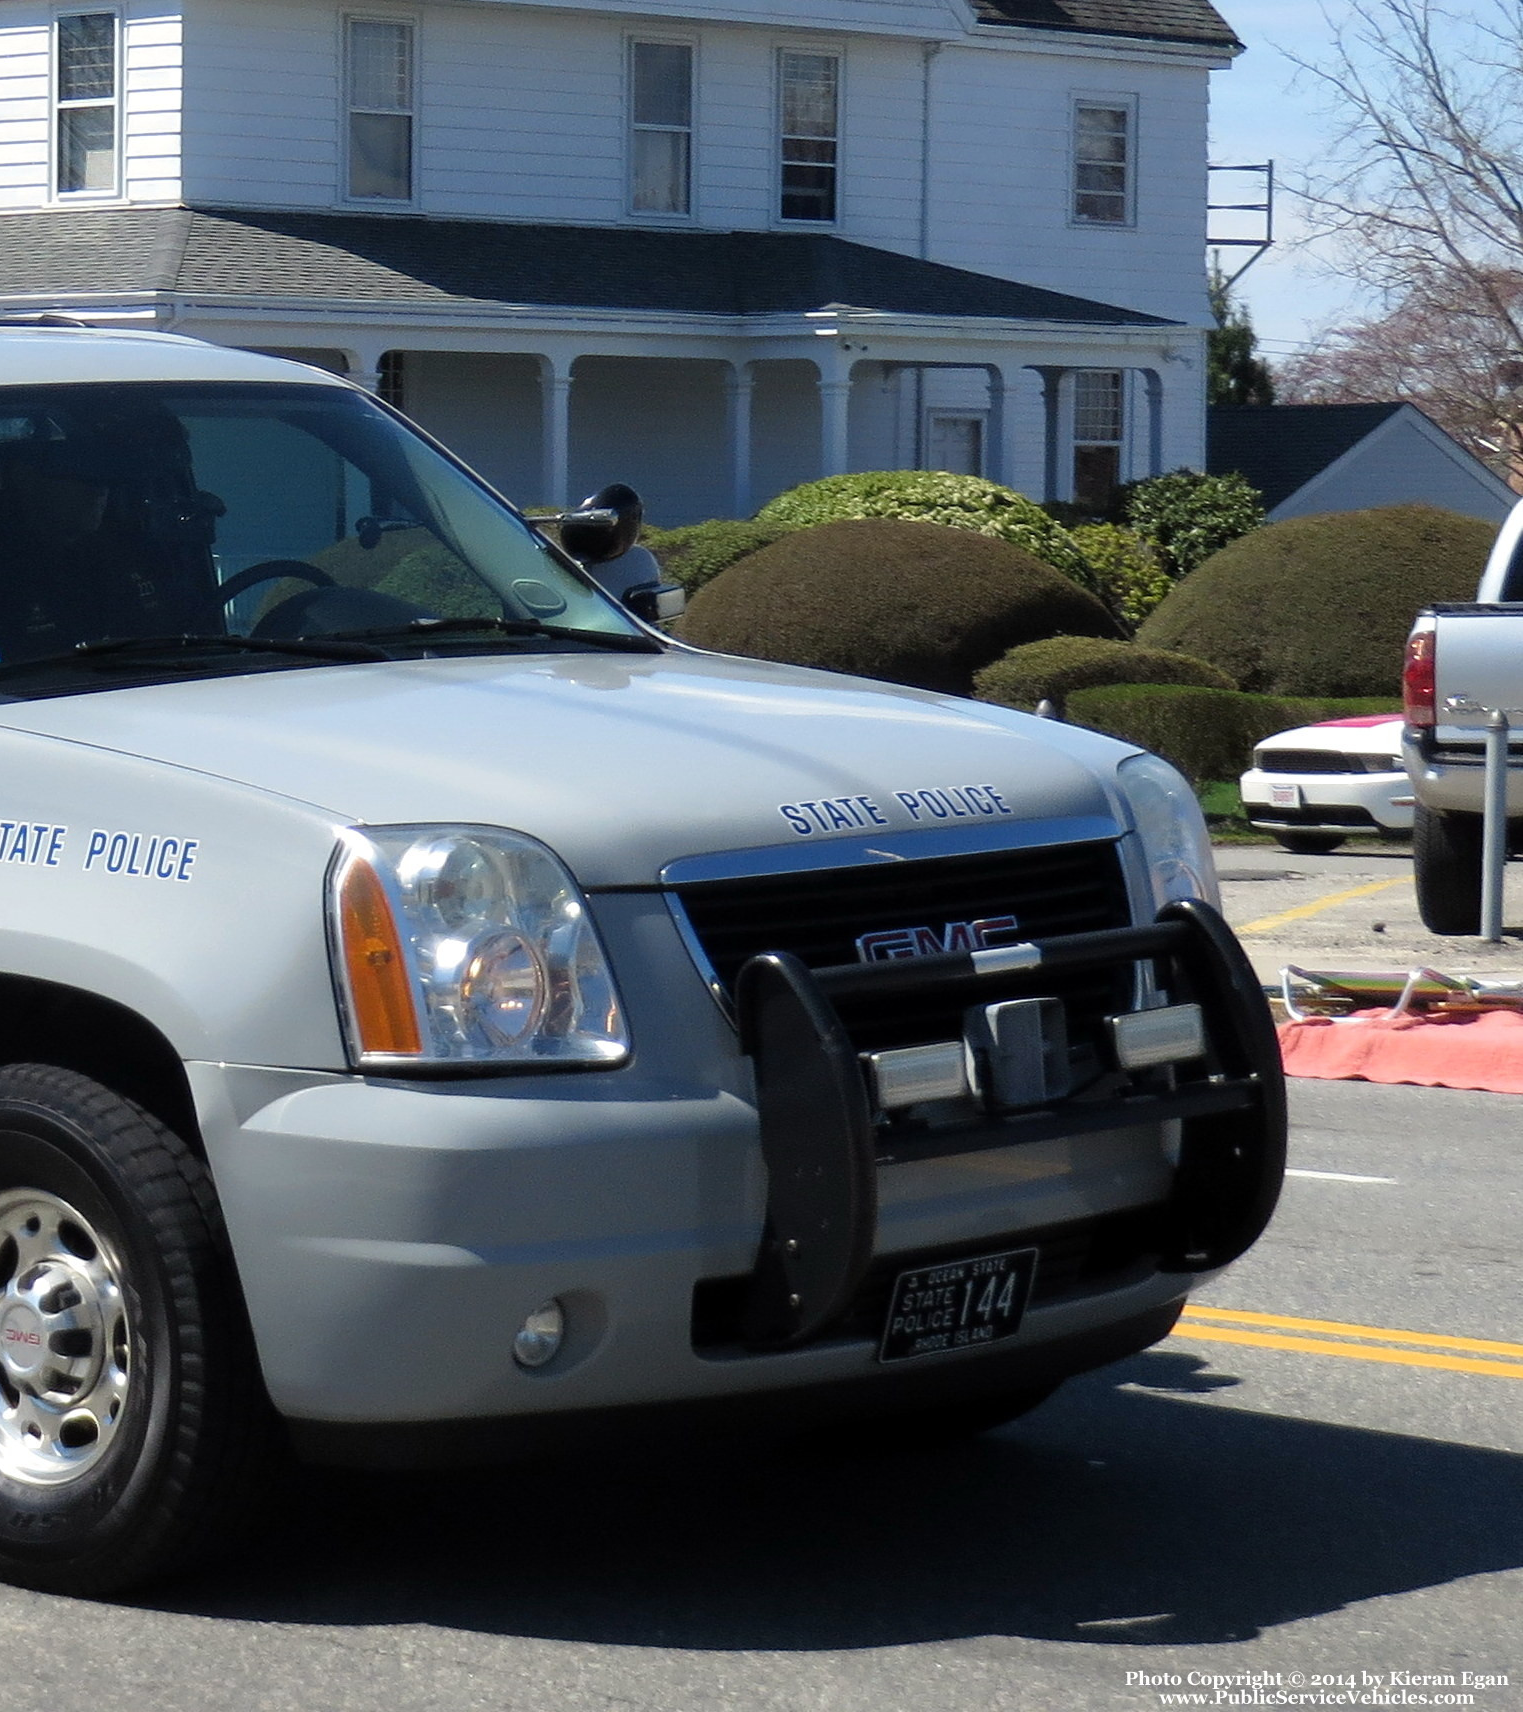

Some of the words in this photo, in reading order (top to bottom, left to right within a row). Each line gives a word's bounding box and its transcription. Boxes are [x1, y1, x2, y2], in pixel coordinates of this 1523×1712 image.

[778, 794, 888, 836] STATE
[892, 784, 1015, 821] POLICE
[82, 828, 200, 883] POLICE
[855, 915, 1018, 962] GMC
[927, 1266, 965, 1285] OCEAN
[972, 1258, 1007, 1276] STATE
[891, 1308, 956, 1336] POLICE
[902, 1286, 956, 1312] STATE
[959, 1271, 1017, 1326] 144
